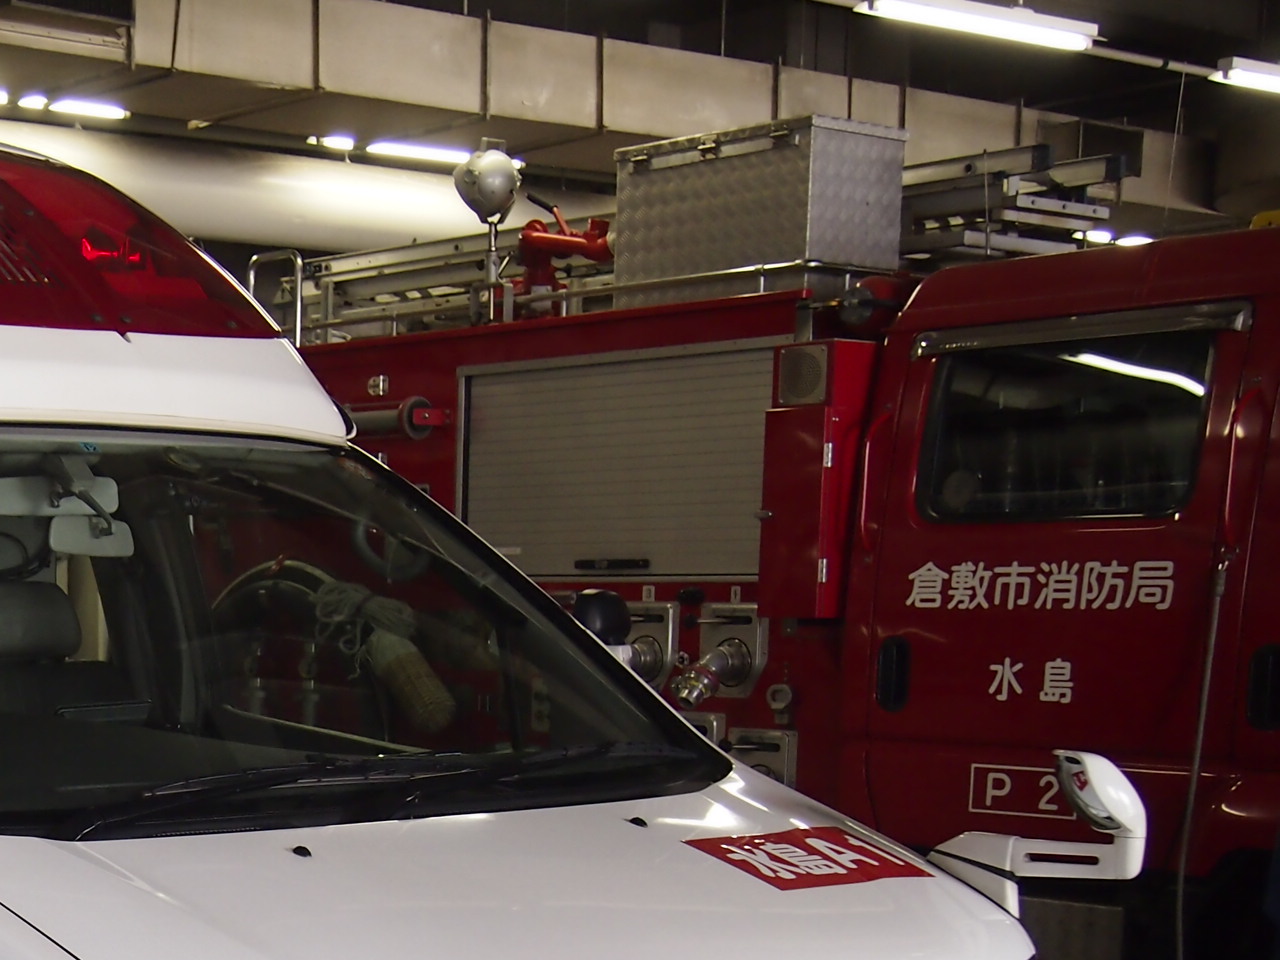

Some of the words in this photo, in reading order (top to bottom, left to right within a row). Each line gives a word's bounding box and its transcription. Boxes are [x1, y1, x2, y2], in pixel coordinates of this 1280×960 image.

[905, 560, 1175, 610] 倉敷市消防局
[988, 657, 1074, 704] 水島
[985, 773, 1011, 807] P
[1038, 775, 1060, 811] 2
